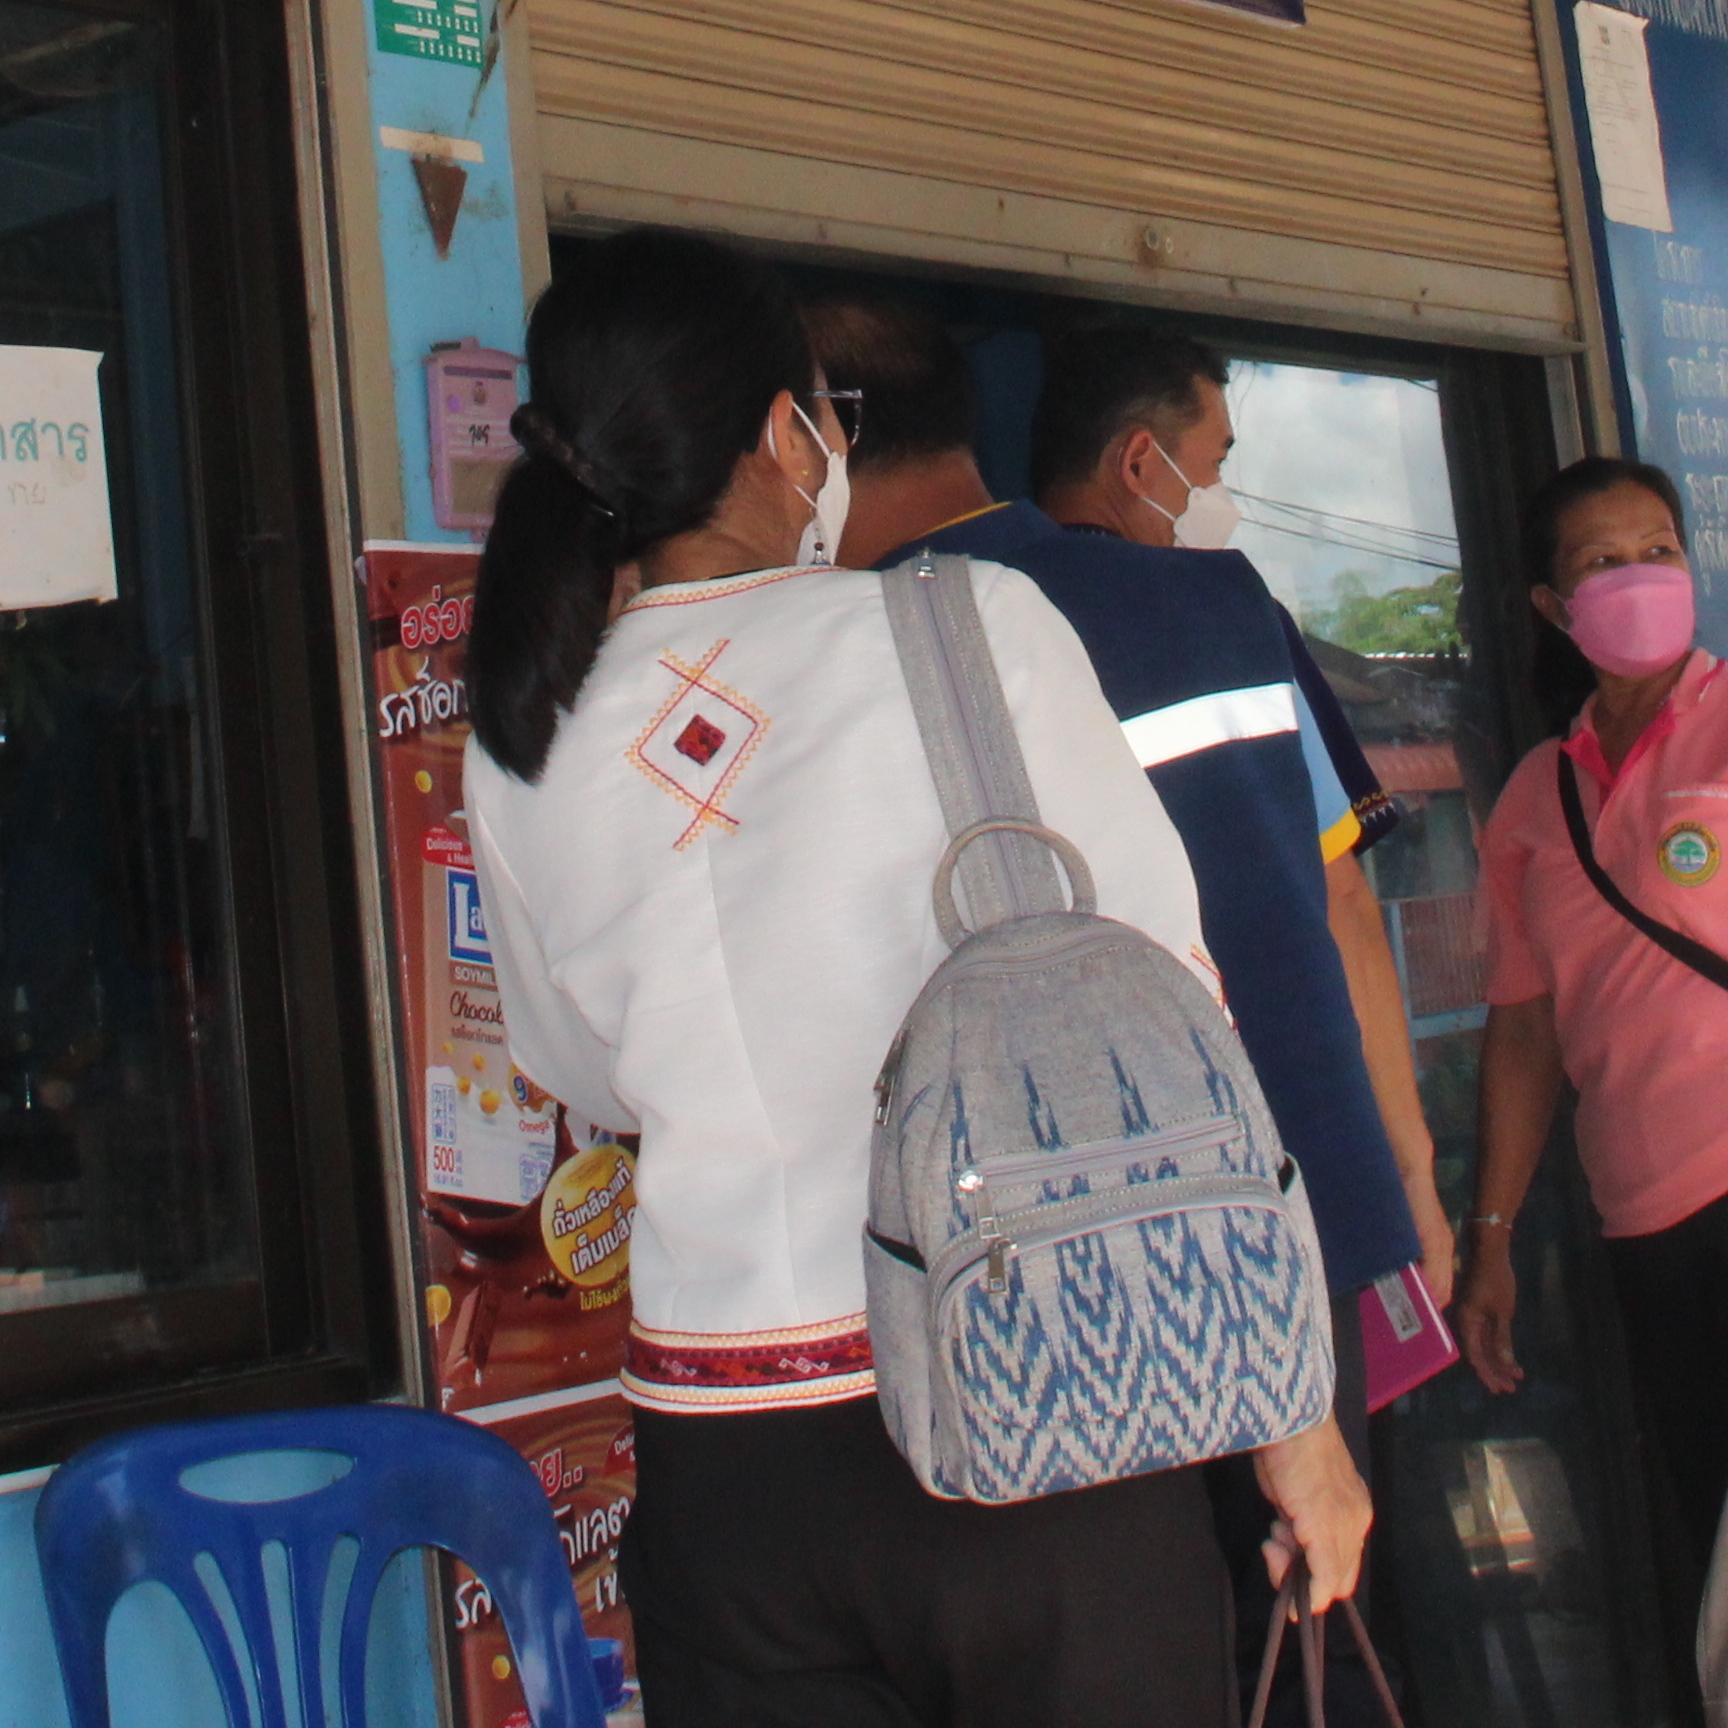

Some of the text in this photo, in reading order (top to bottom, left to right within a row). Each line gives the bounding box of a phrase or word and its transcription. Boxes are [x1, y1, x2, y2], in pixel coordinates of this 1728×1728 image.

[453, 881, 491, 955] La
[455, 966, 497, 985] SOYMIL
[450, 991, 504, 1025] Chocol
[433, 1144, 455, 1173] 500
